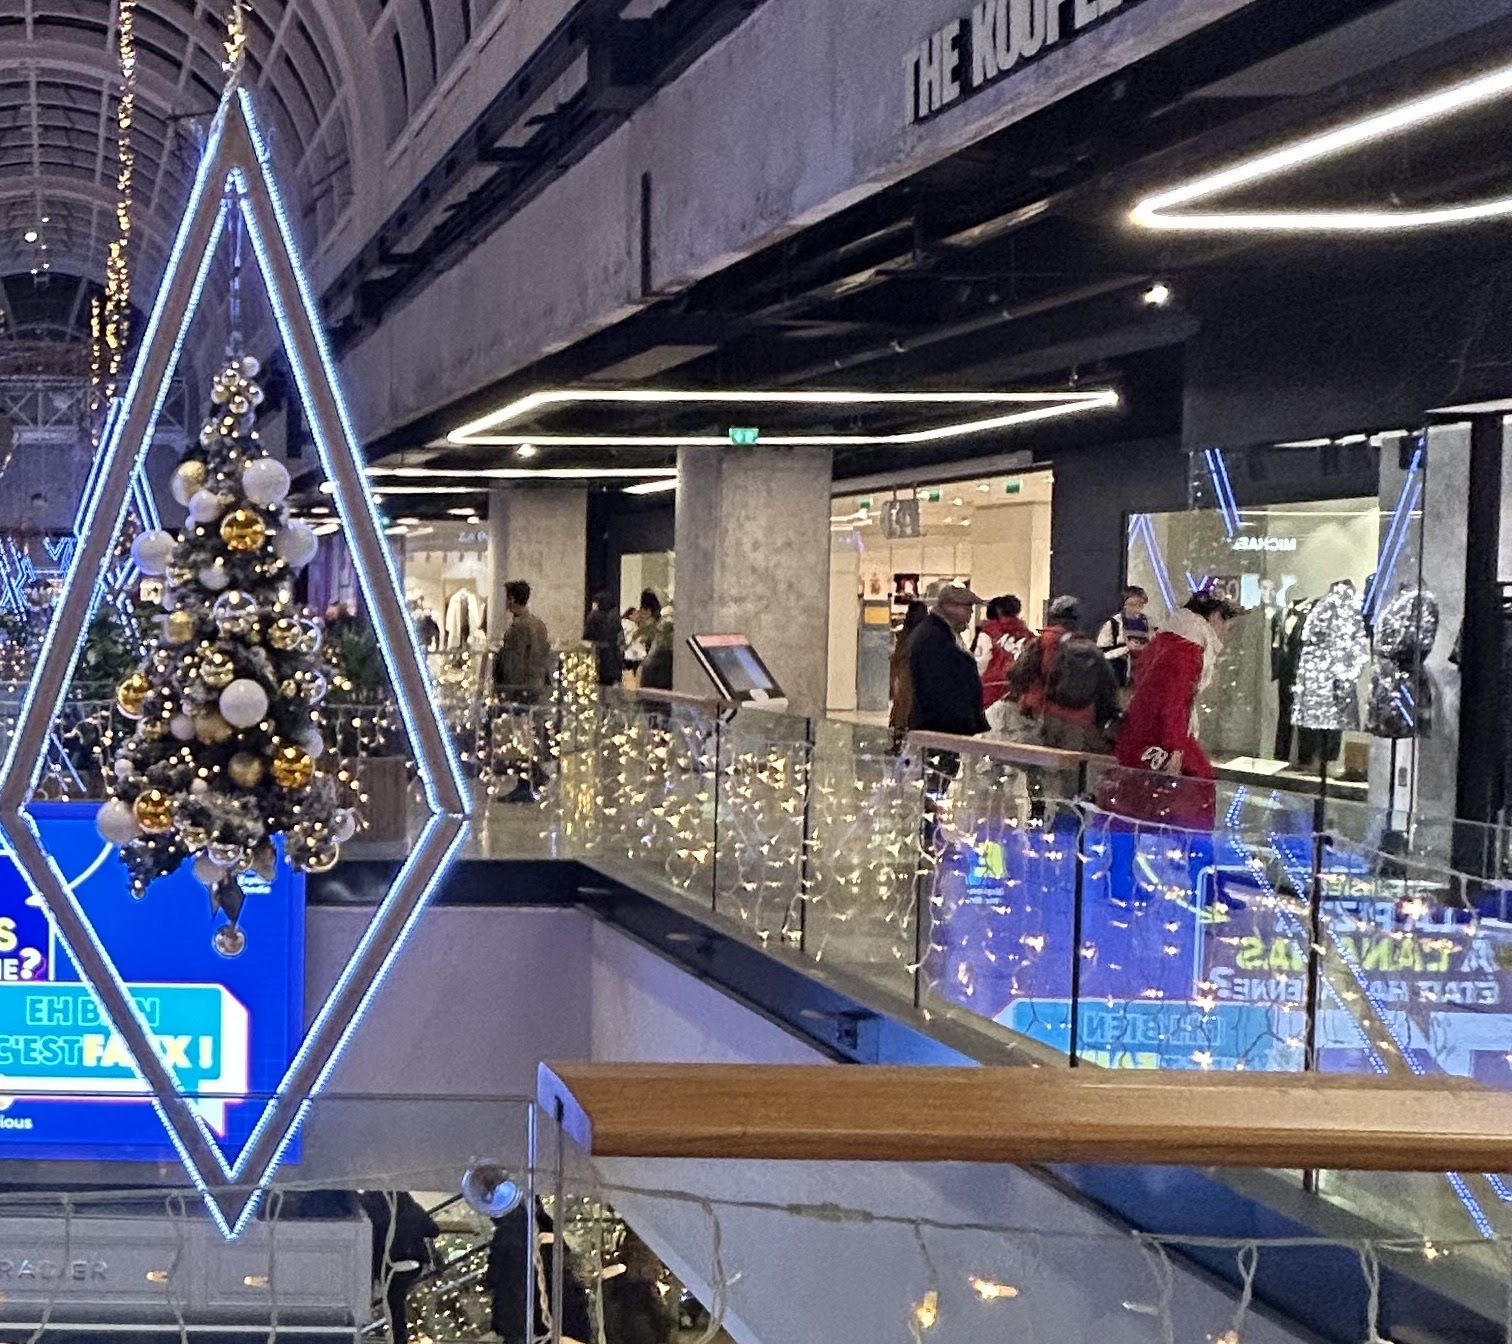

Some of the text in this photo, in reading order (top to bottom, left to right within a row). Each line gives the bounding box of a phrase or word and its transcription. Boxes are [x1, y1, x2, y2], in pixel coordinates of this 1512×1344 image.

[904, 19, 960, 125] THE
[26, 996, 160, 1026] EH BN
[82, 1034, 192, 1068] FAX
